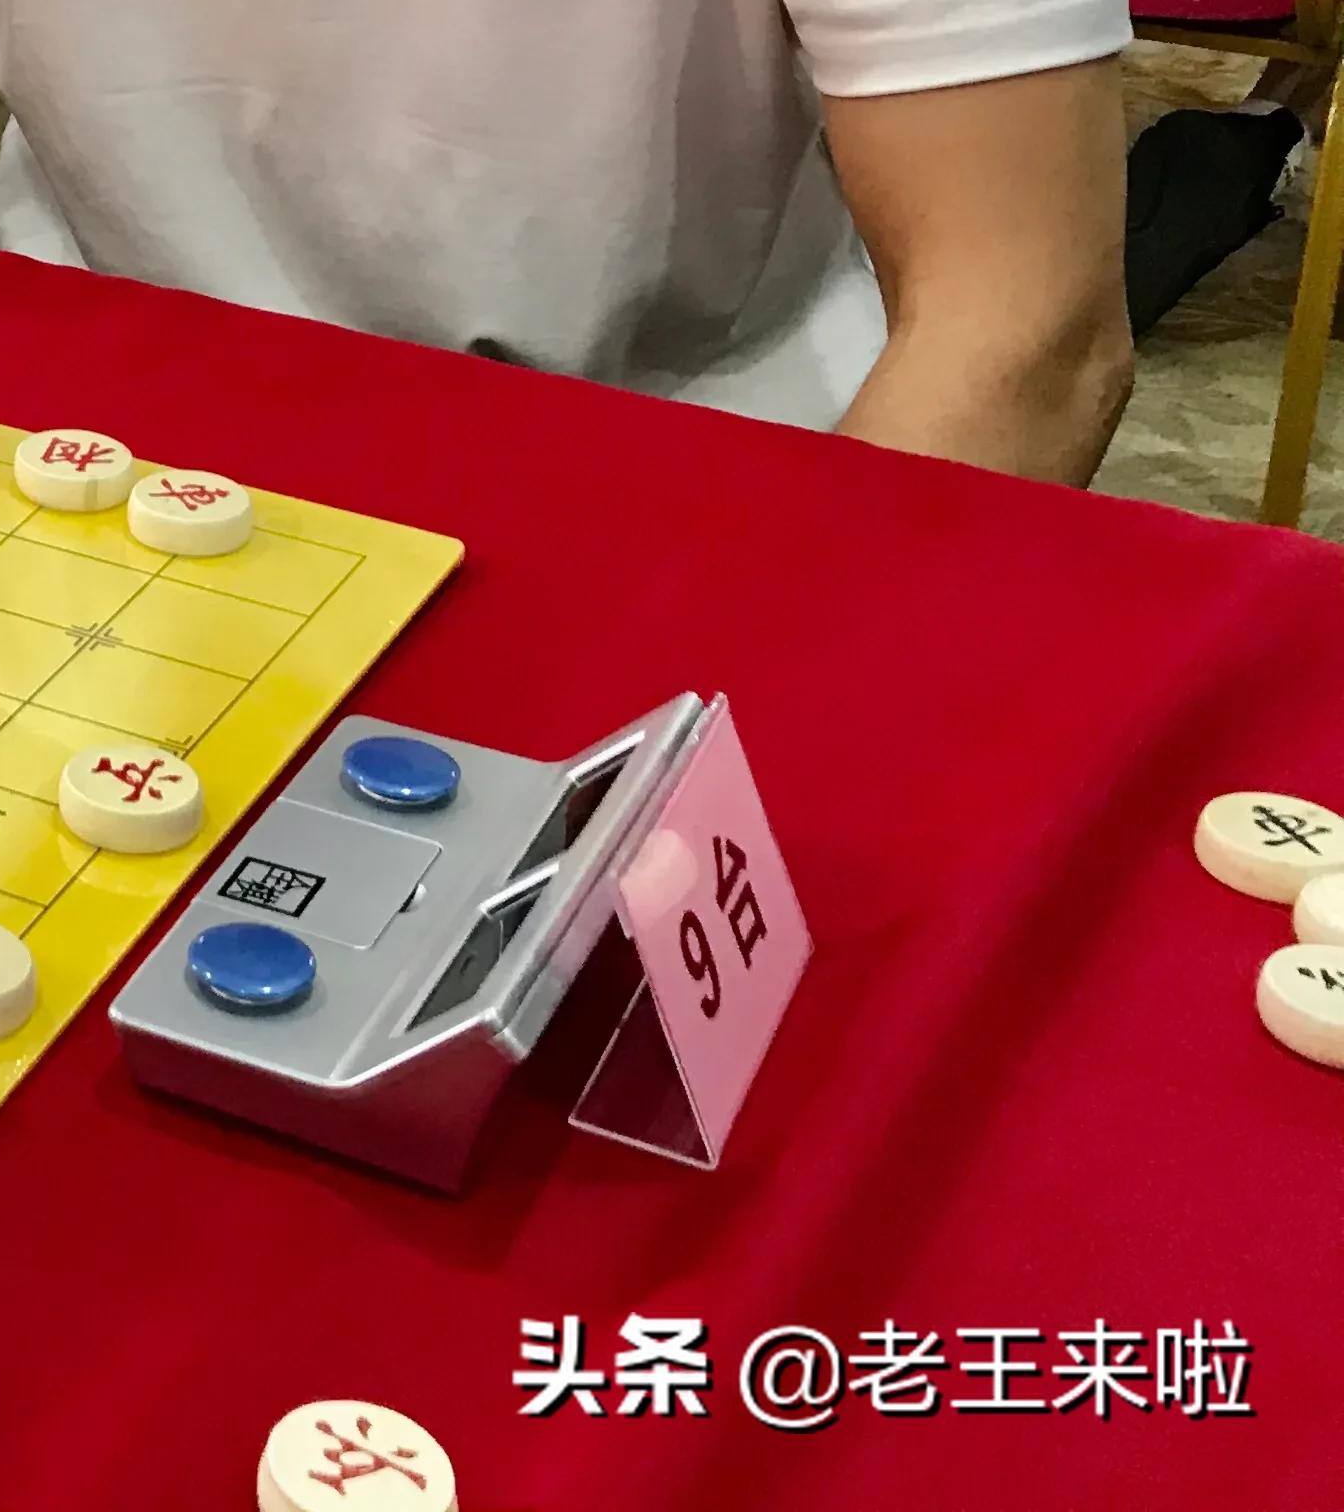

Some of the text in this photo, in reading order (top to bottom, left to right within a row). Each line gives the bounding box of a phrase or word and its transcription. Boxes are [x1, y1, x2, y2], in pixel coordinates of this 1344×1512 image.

[39, 437, 113, 472] 相
[94, 758, 181, 803] 兵
[306, 1410, 429, 1496] 兵
